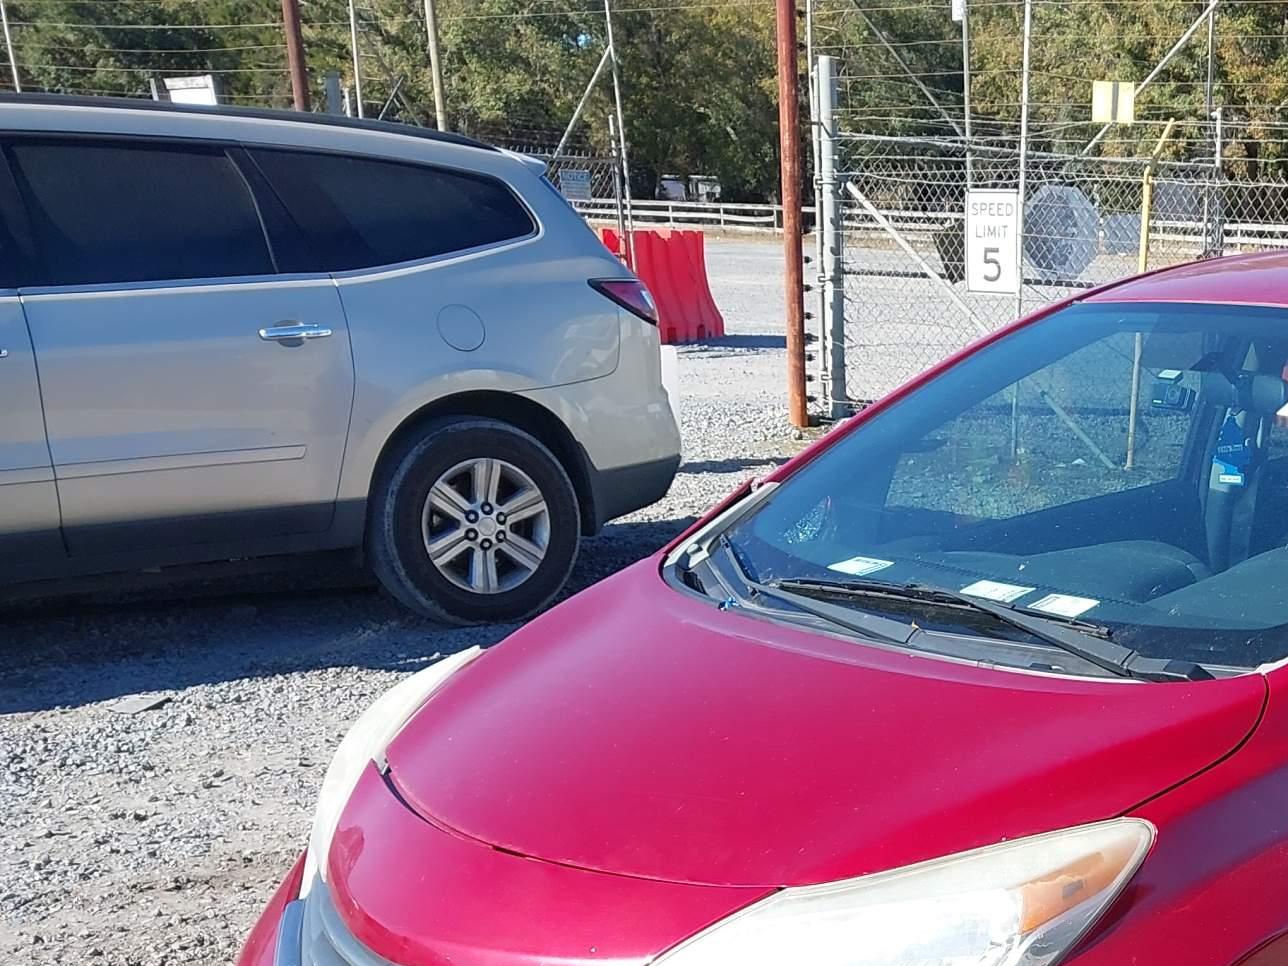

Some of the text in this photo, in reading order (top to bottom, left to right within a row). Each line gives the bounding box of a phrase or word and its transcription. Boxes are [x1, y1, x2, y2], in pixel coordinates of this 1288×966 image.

[971, 202, 1014, 217] SPEED
[975, 224, 1008, 239] LIMIT
[983, 247, 1002, 282] 5
